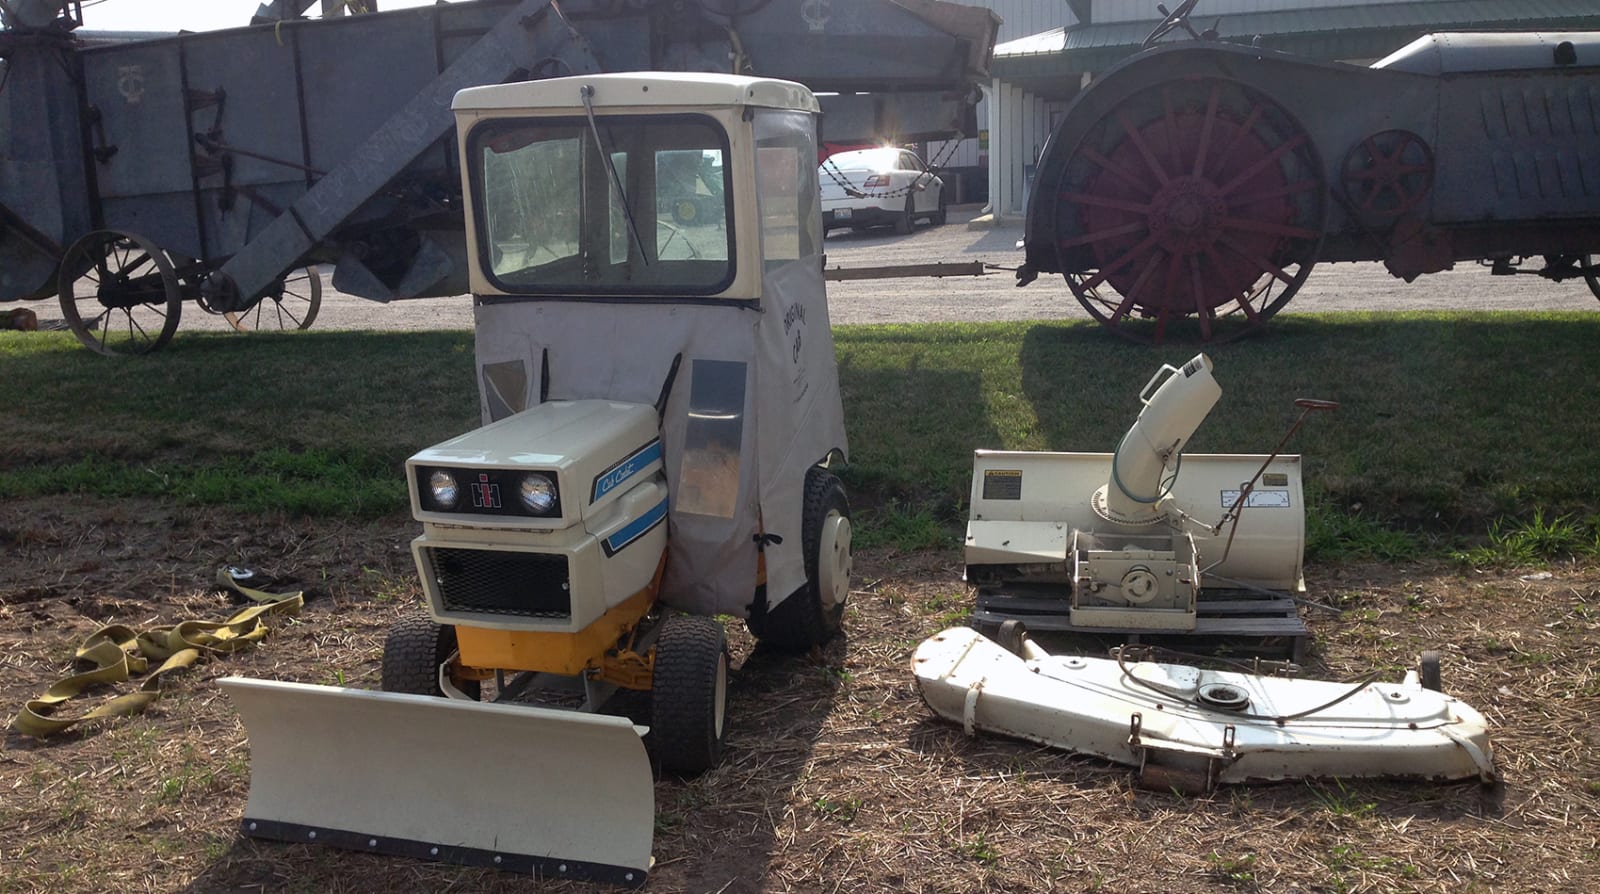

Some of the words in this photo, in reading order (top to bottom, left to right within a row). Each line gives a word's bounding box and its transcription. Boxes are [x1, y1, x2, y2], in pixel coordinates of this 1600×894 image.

[784, 303, 806, 336] ORIGINAL
[793, 329, 802, 364] CAB
[602, 476, 614, 492] Cub
[615, 463, 634, 483] Cadet
